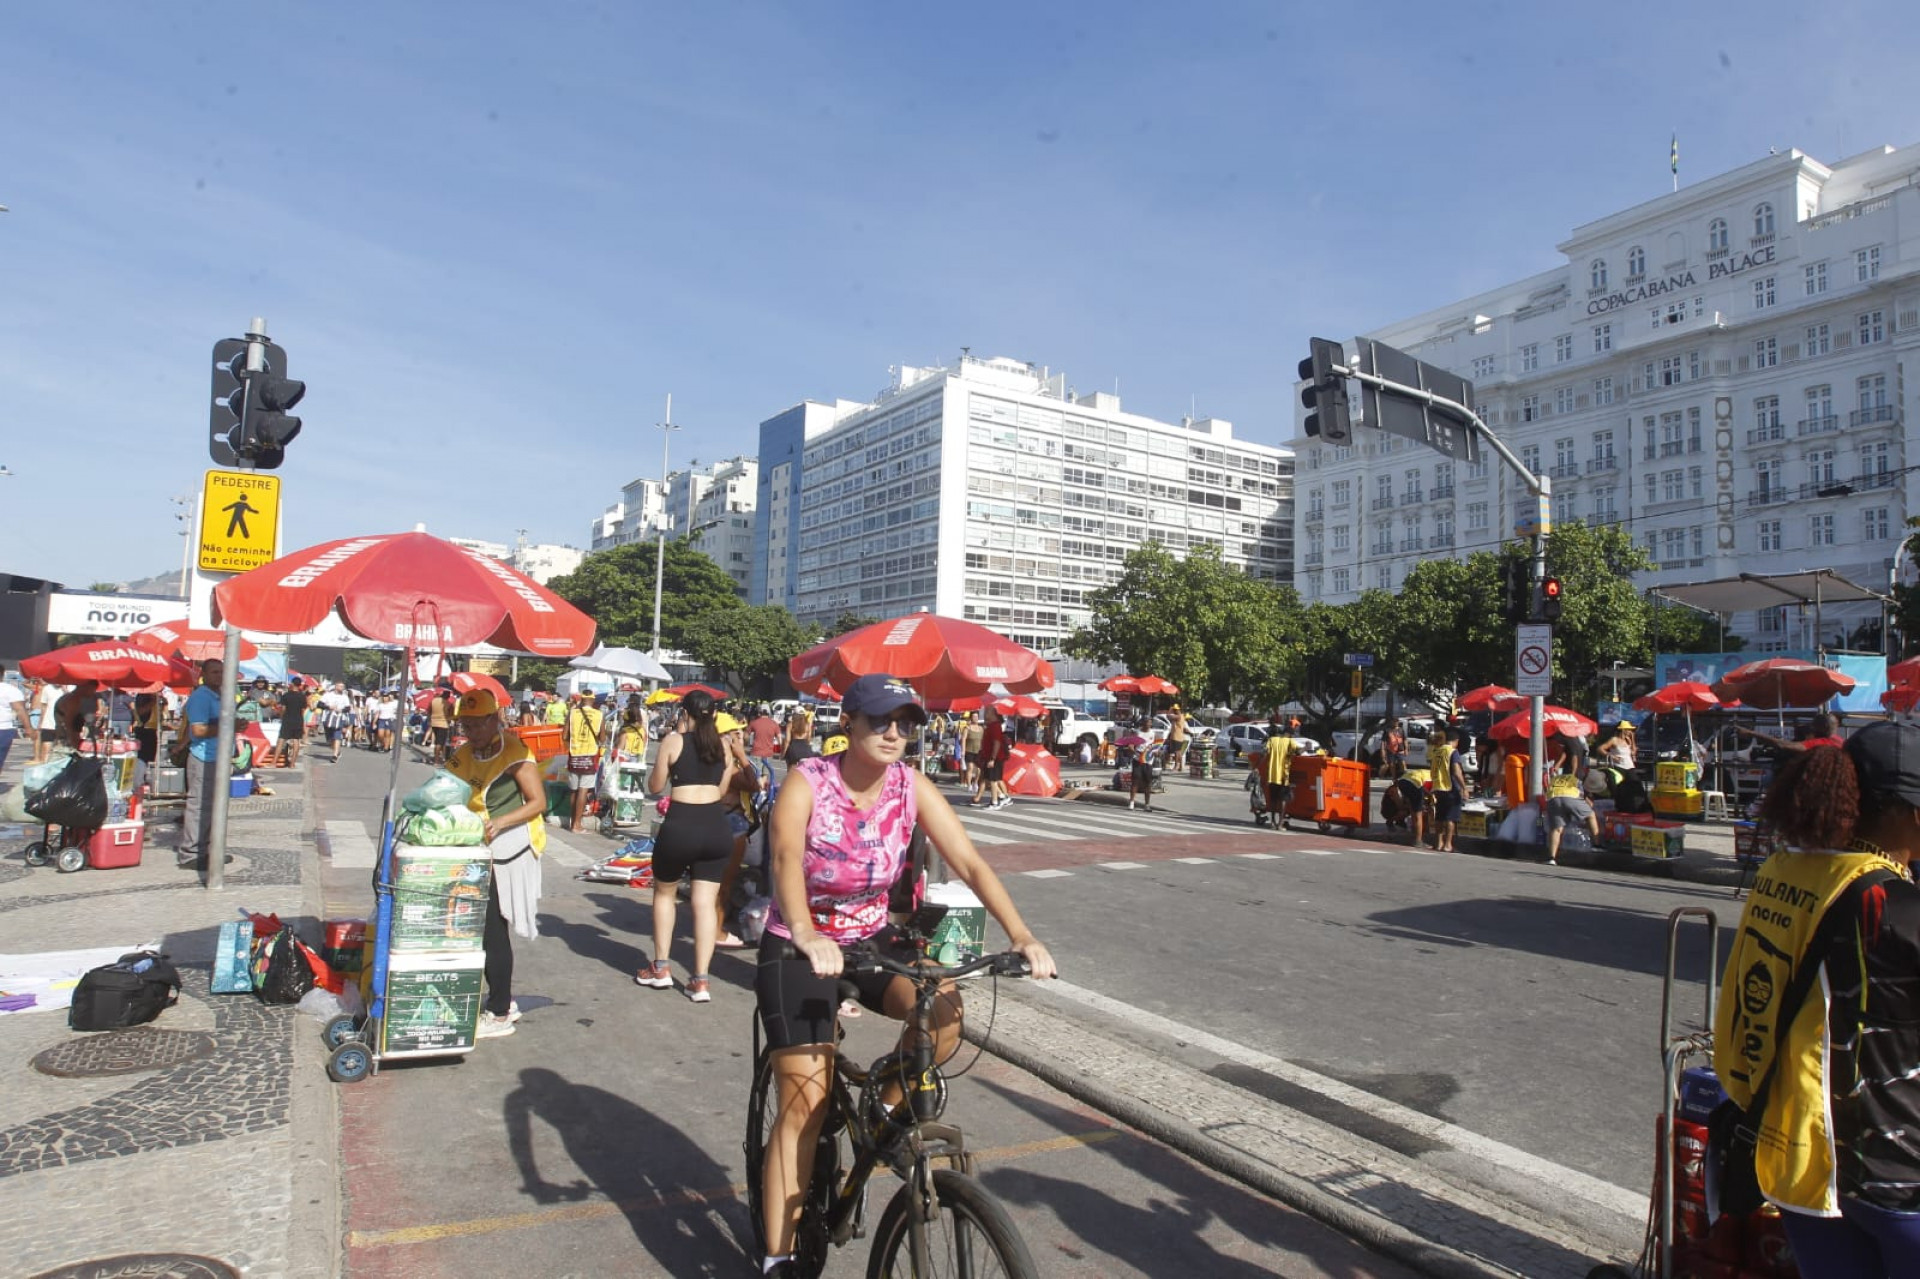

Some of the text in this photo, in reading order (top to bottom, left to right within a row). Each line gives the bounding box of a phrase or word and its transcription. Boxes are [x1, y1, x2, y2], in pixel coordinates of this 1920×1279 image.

[1587, 246, 1776, 315] COPACABANA PALACE
[213, 475, 272, 490] PEDESTRE
[202, 556, 217, 564] na
[88, 647, 169, 667] BRAHMA
[415, 972, 459, 983] BEATS
